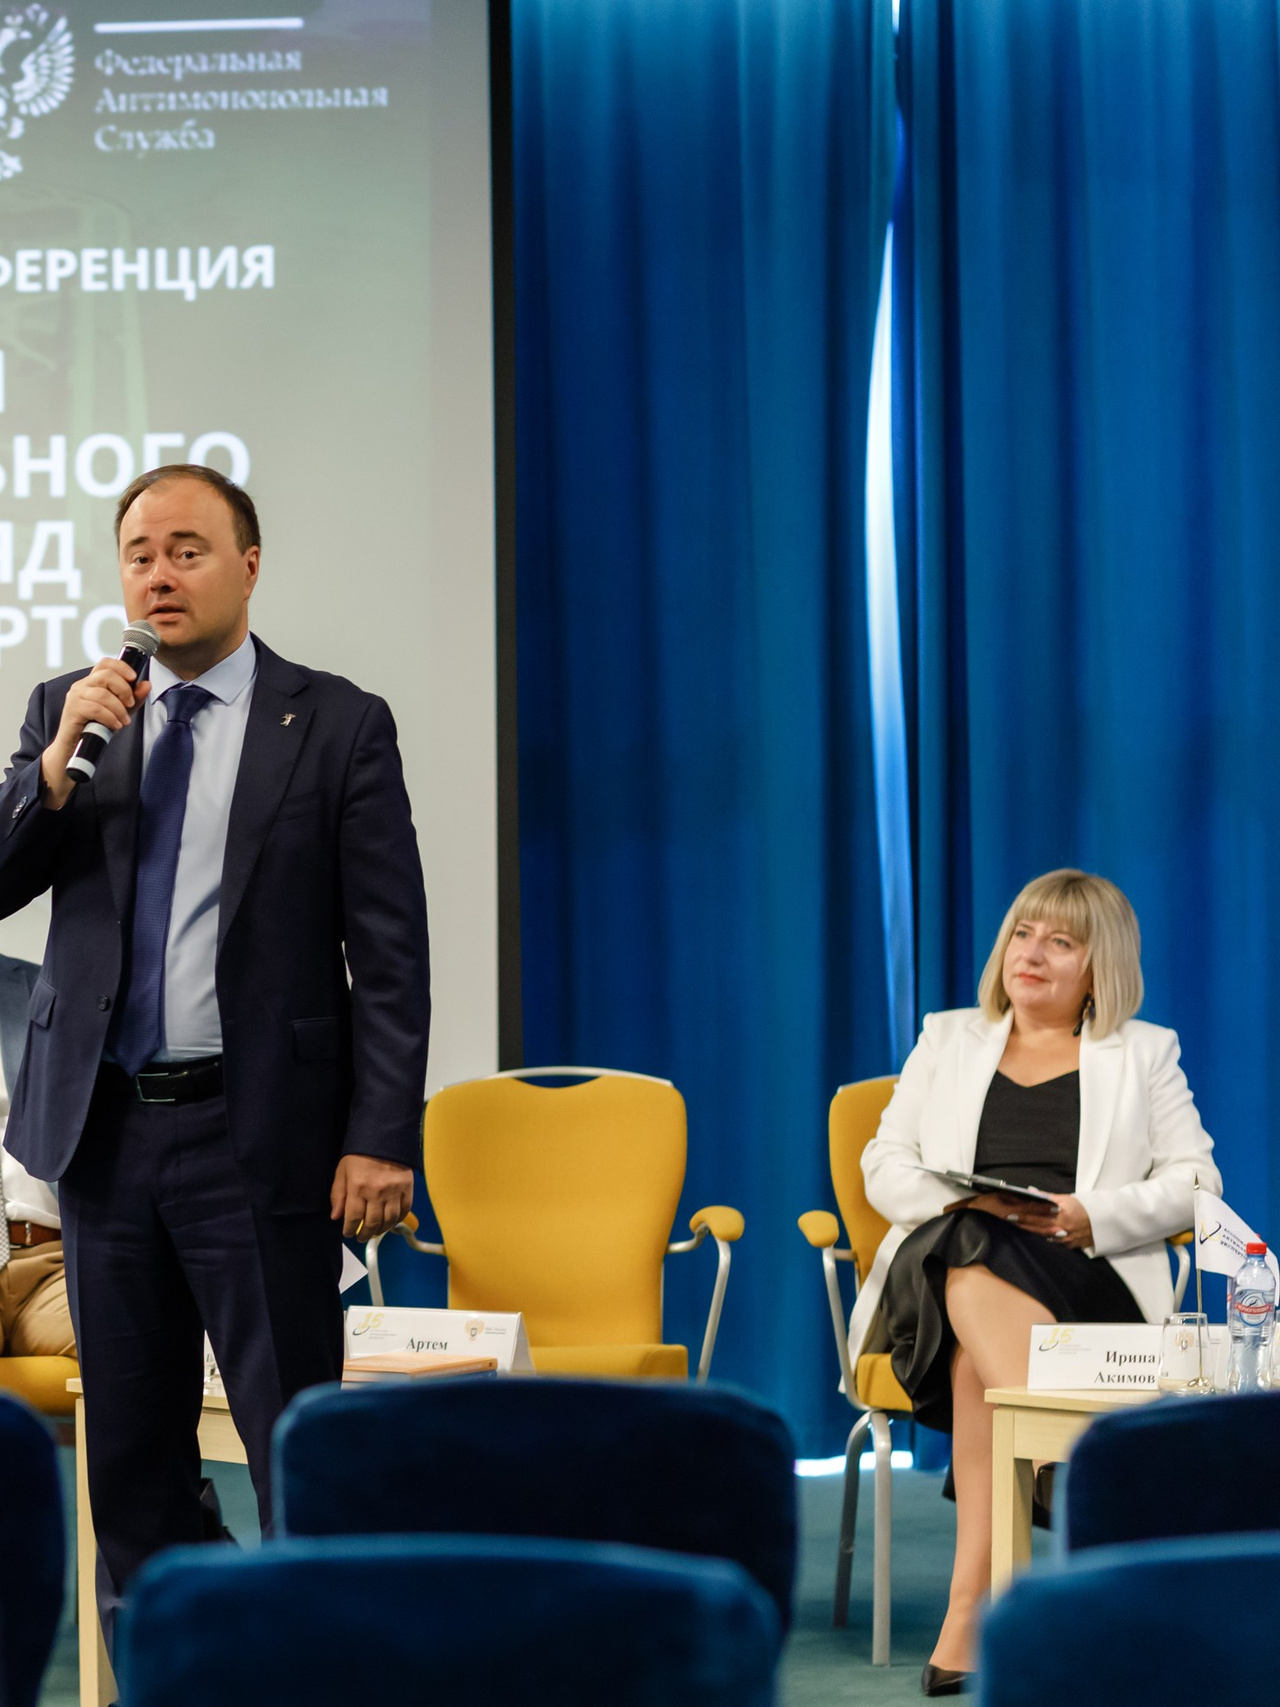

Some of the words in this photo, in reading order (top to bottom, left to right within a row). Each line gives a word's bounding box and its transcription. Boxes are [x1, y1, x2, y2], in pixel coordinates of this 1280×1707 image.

[94, 49, 302, 81] Федеральная
[95, 86, 389, 114] Антимонопольная
[94, 119, 216, 158] Служба
[406, 1337, 448, 1353] Артем
[1105, 1350, 1156, 1366] Ирина
[1093, 1370, 1157, 1384] Акимов
